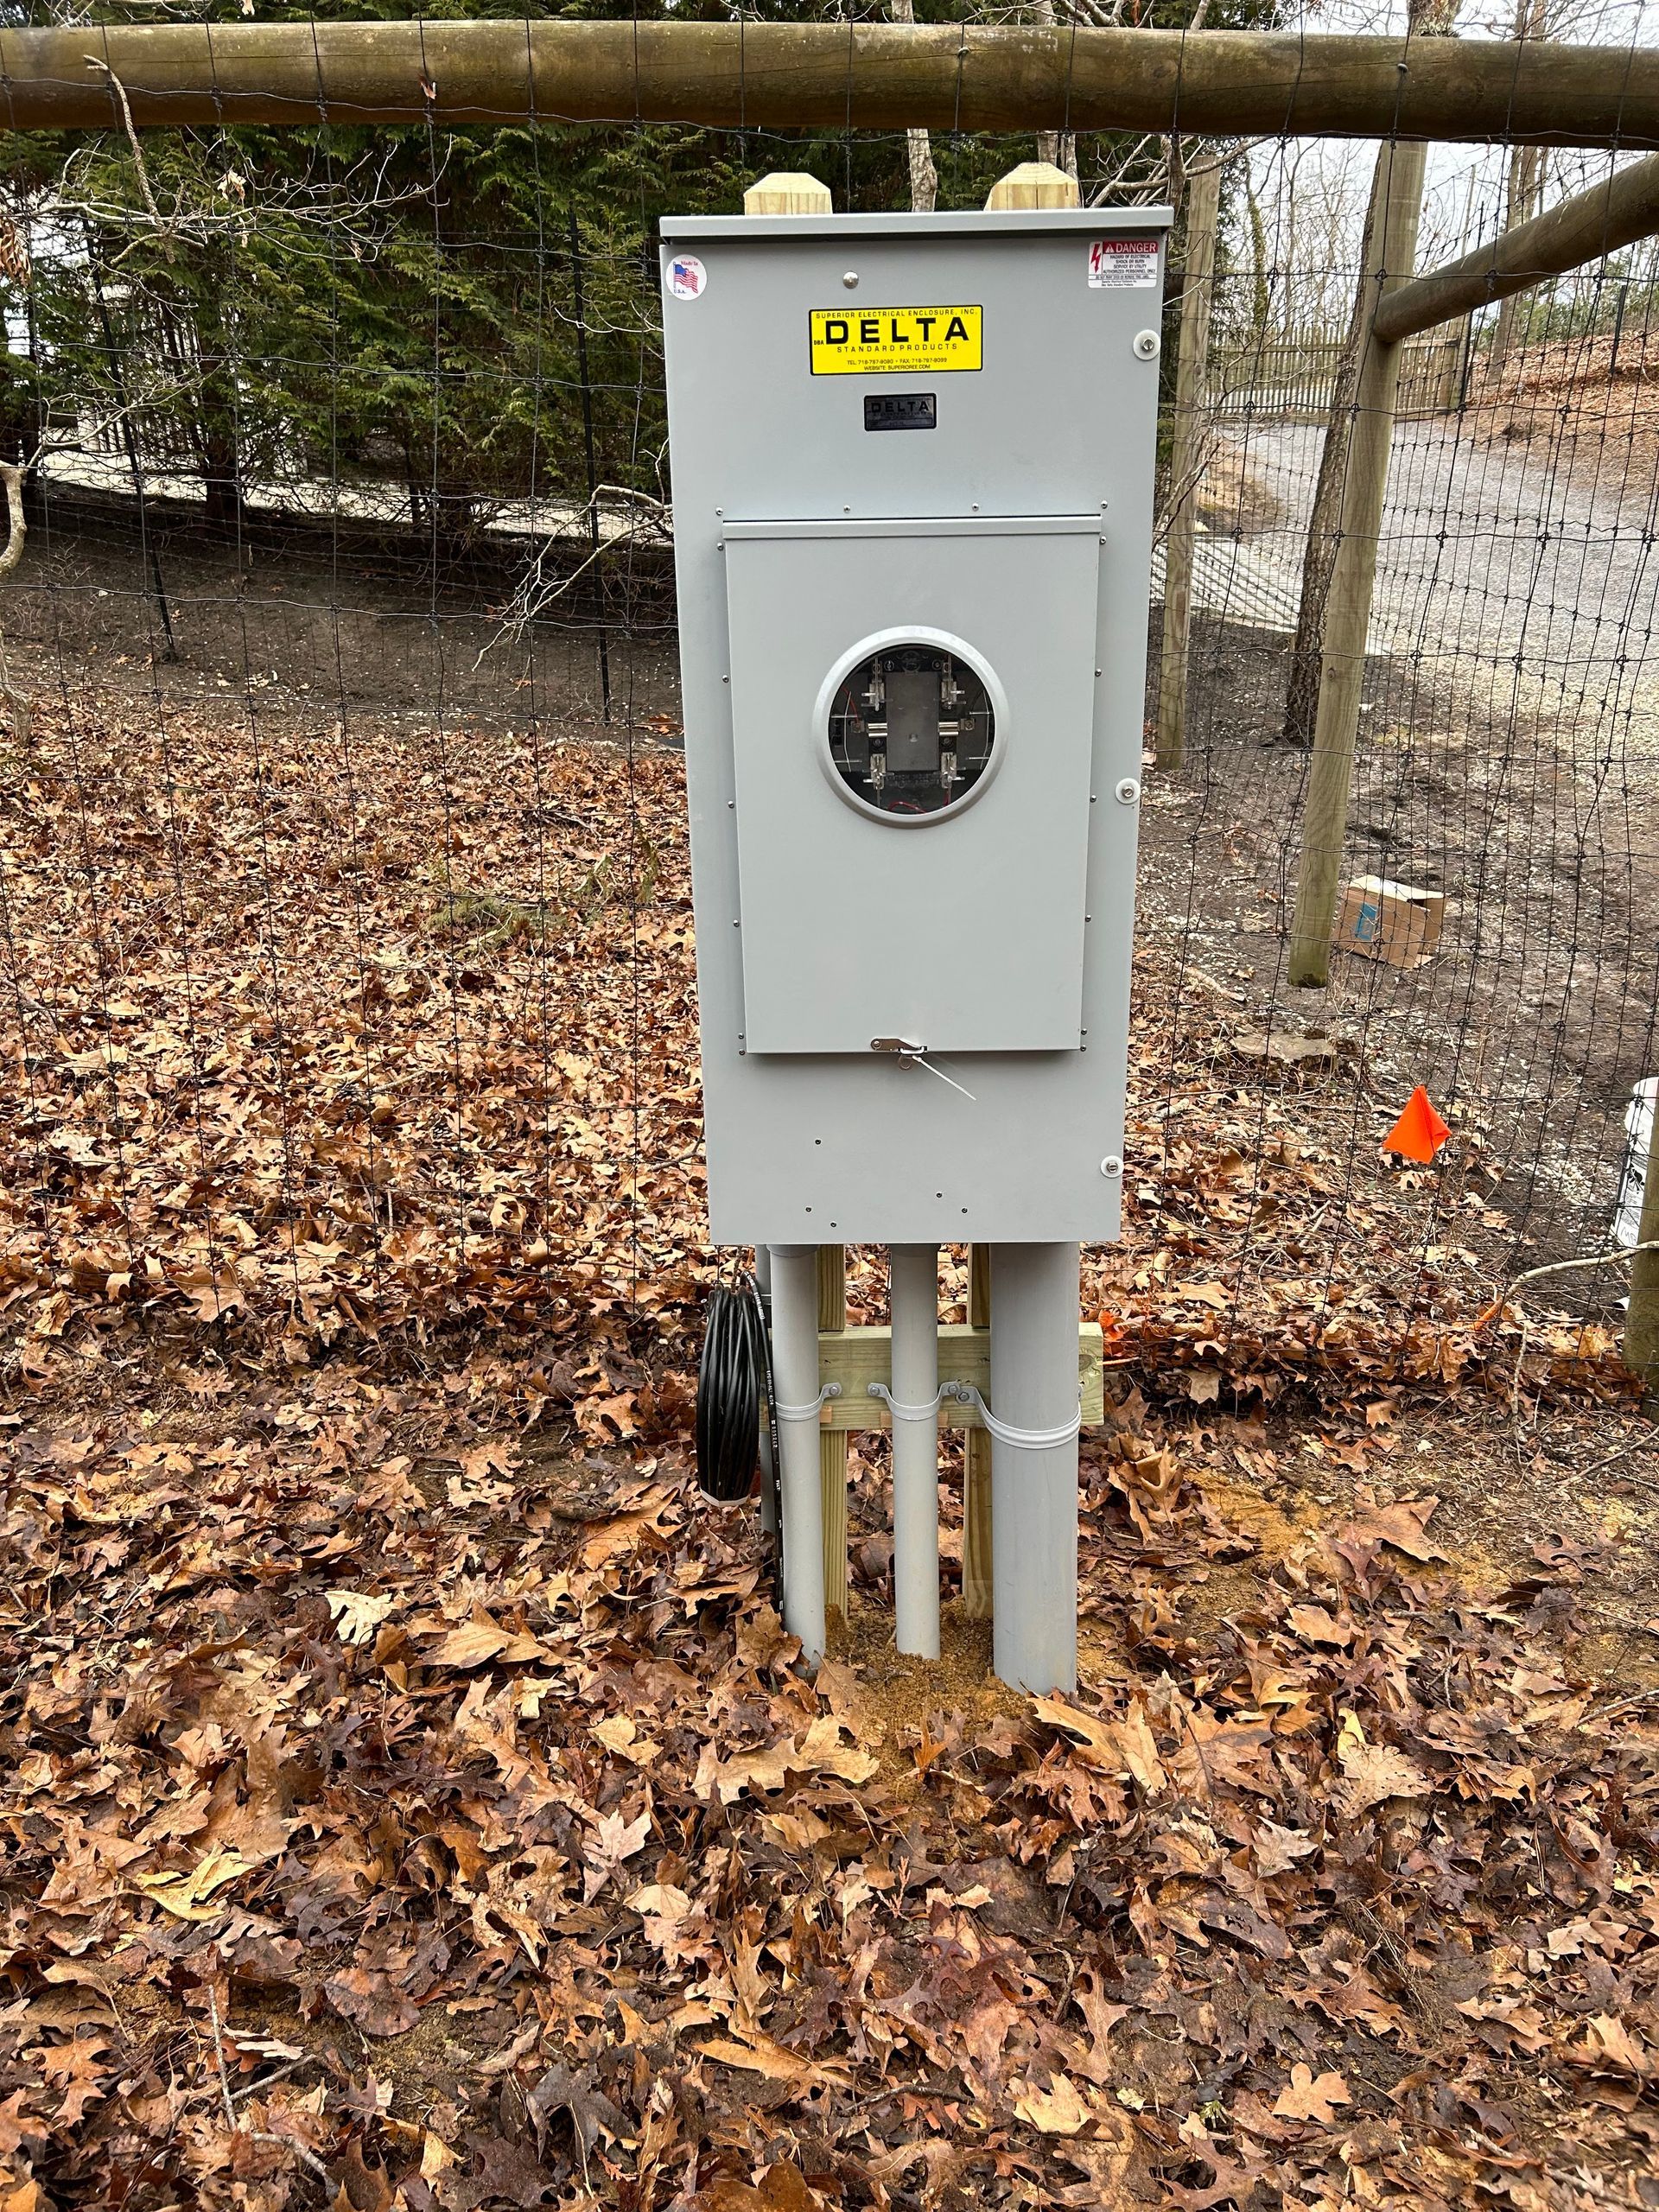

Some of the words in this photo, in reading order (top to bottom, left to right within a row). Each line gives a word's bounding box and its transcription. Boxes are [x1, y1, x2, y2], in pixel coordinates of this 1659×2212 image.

[1116, 243, 1156, 253] DANGER
[825, 316, 969, 345] DELTA
[871, 400, 929, 413] DELTA
